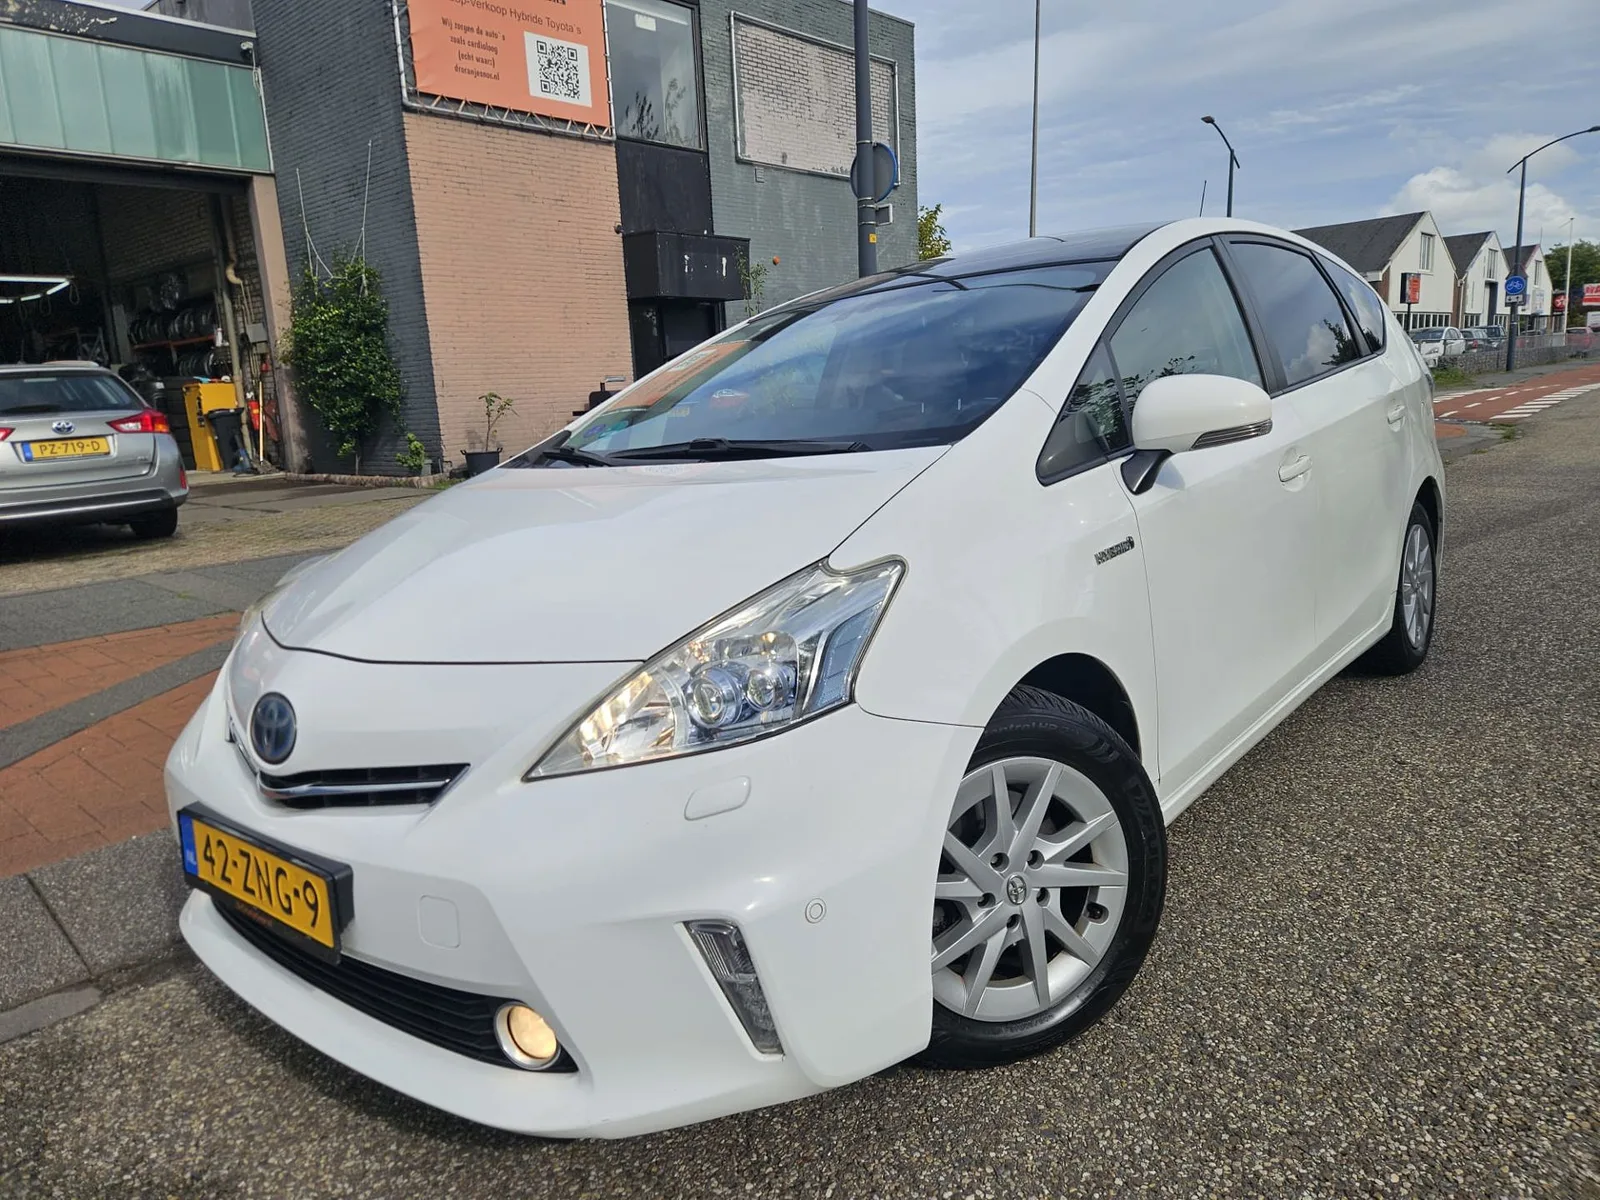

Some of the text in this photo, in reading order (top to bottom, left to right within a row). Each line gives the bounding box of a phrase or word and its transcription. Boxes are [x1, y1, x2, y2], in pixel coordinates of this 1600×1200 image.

[509, 8, 543, 25] Hybride
[441, 17, 453, 30] Wij
[475, 26, 483, 36] de
[450, 35, 498, 55] zoals cardioloog
[39, 440, 100, 455] PZ-719-D
[203, 834, 319, 929] 42-ZNG-9
